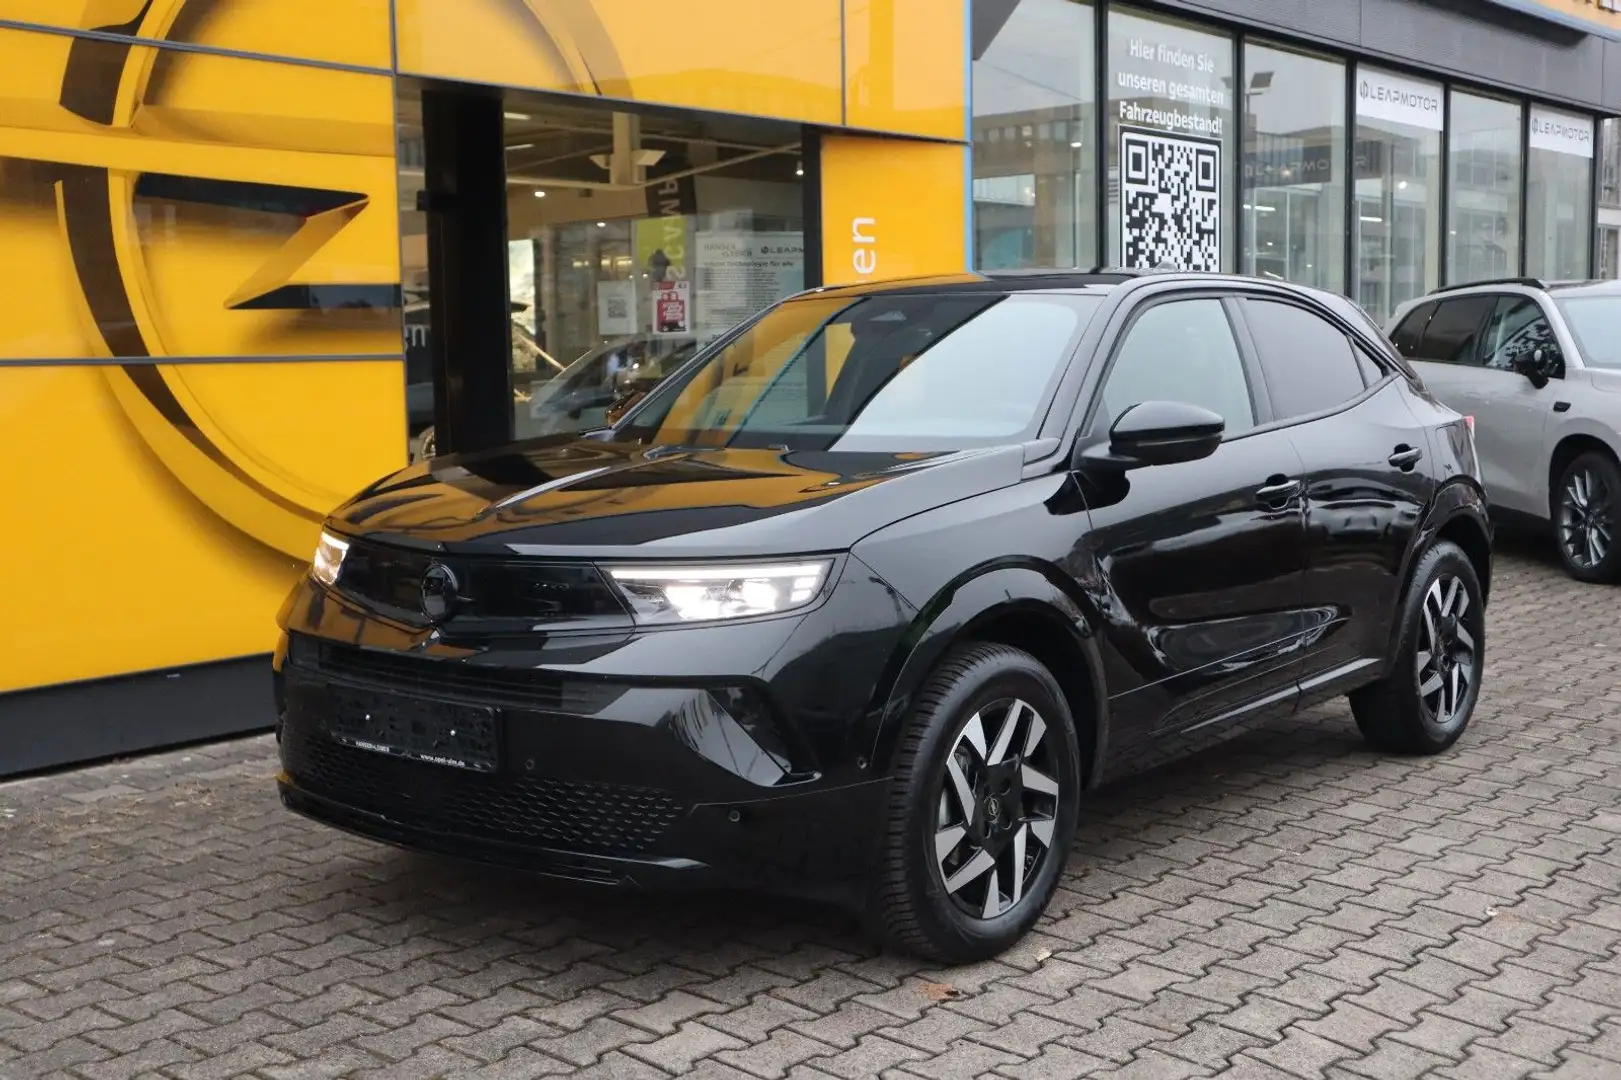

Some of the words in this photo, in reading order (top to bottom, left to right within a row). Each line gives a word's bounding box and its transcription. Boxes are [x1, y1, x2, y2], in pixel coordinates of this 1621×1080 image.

[1130, 38, 1155, 60] Hier
[1157, 44, 1195, 69] finden
[1197, 53, 1215, 73] Sie
[1118, 71, 1166, 94] unseren
[1168, 81, 1224, 105] gesamten
[1370, 86, 1438, 113] LEAPMOTOR
[1119, 100, 1223, 134] Fahrzeugbestand!
[1539, 122, 1590, 141] LEAPMOTOR
